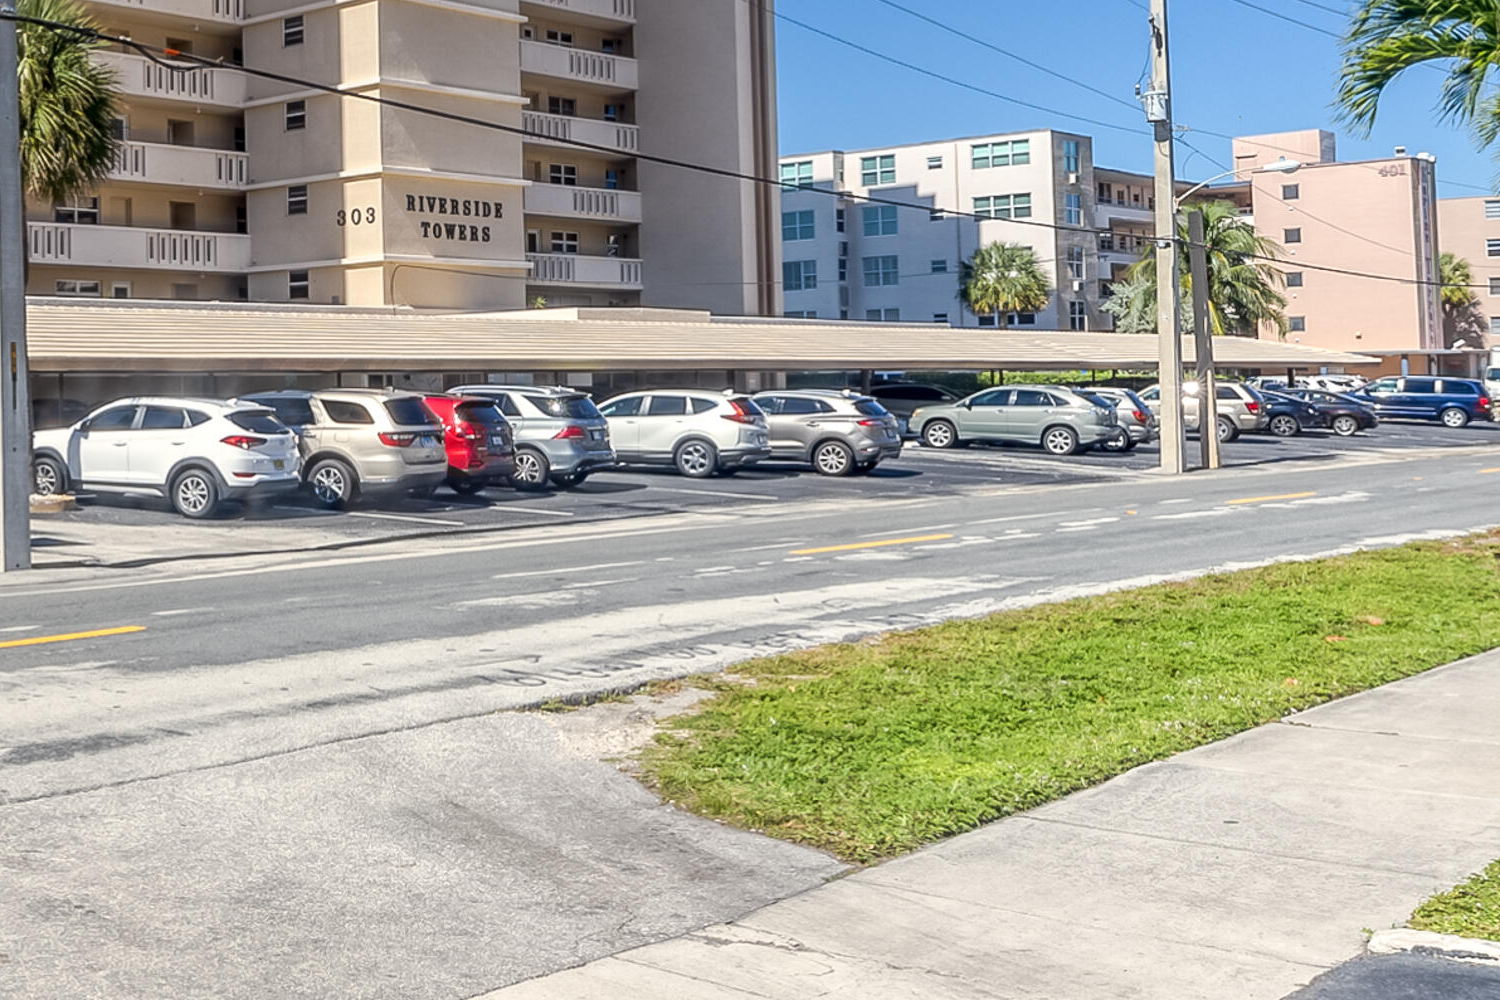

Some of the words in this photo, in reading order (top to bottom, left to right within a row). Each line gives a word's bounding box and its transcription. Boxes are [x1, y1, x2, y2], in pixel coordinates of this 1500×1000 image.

[337, 207, 376, 227] 303
[406, 194, 503, 219] RIVERSIDE
[421, 221, 491, 242] TOWERS
